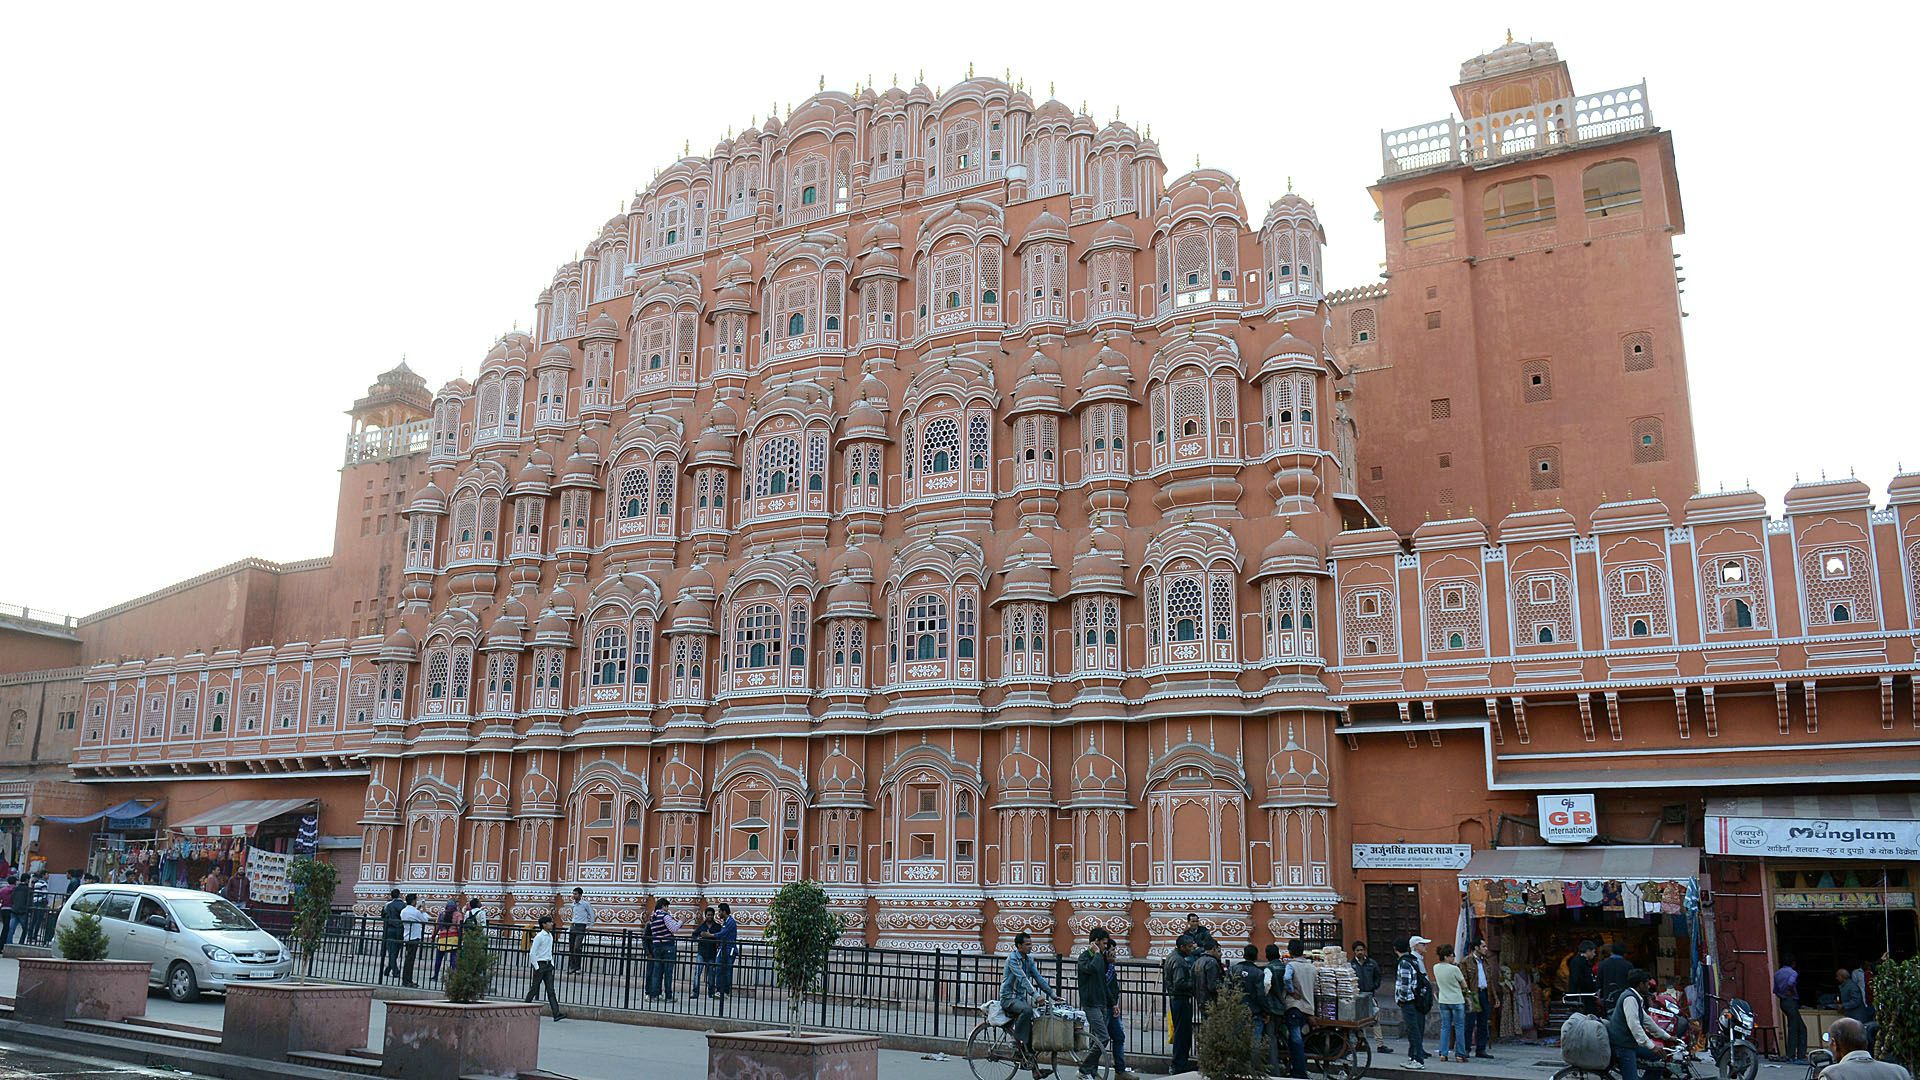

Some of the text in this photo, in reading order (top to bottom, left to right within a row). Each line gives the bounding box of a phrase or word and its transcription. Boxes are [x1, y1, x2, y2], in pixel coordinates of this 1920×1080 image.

[1548, 826, 1593, 835] International
[1735, 829, 1764, 838] जयपुरी
[1788, 822, 1896, 842] Manglam
[1370, 845, 1406, 856] अर्जुनसिंह
[1408, 847, 1433, 855] तलवार
[1436, 847, 1453, 855] साज
[1869, 846, 1877, 854] के
[1895, 846, 1918, 856] विक्रेता
